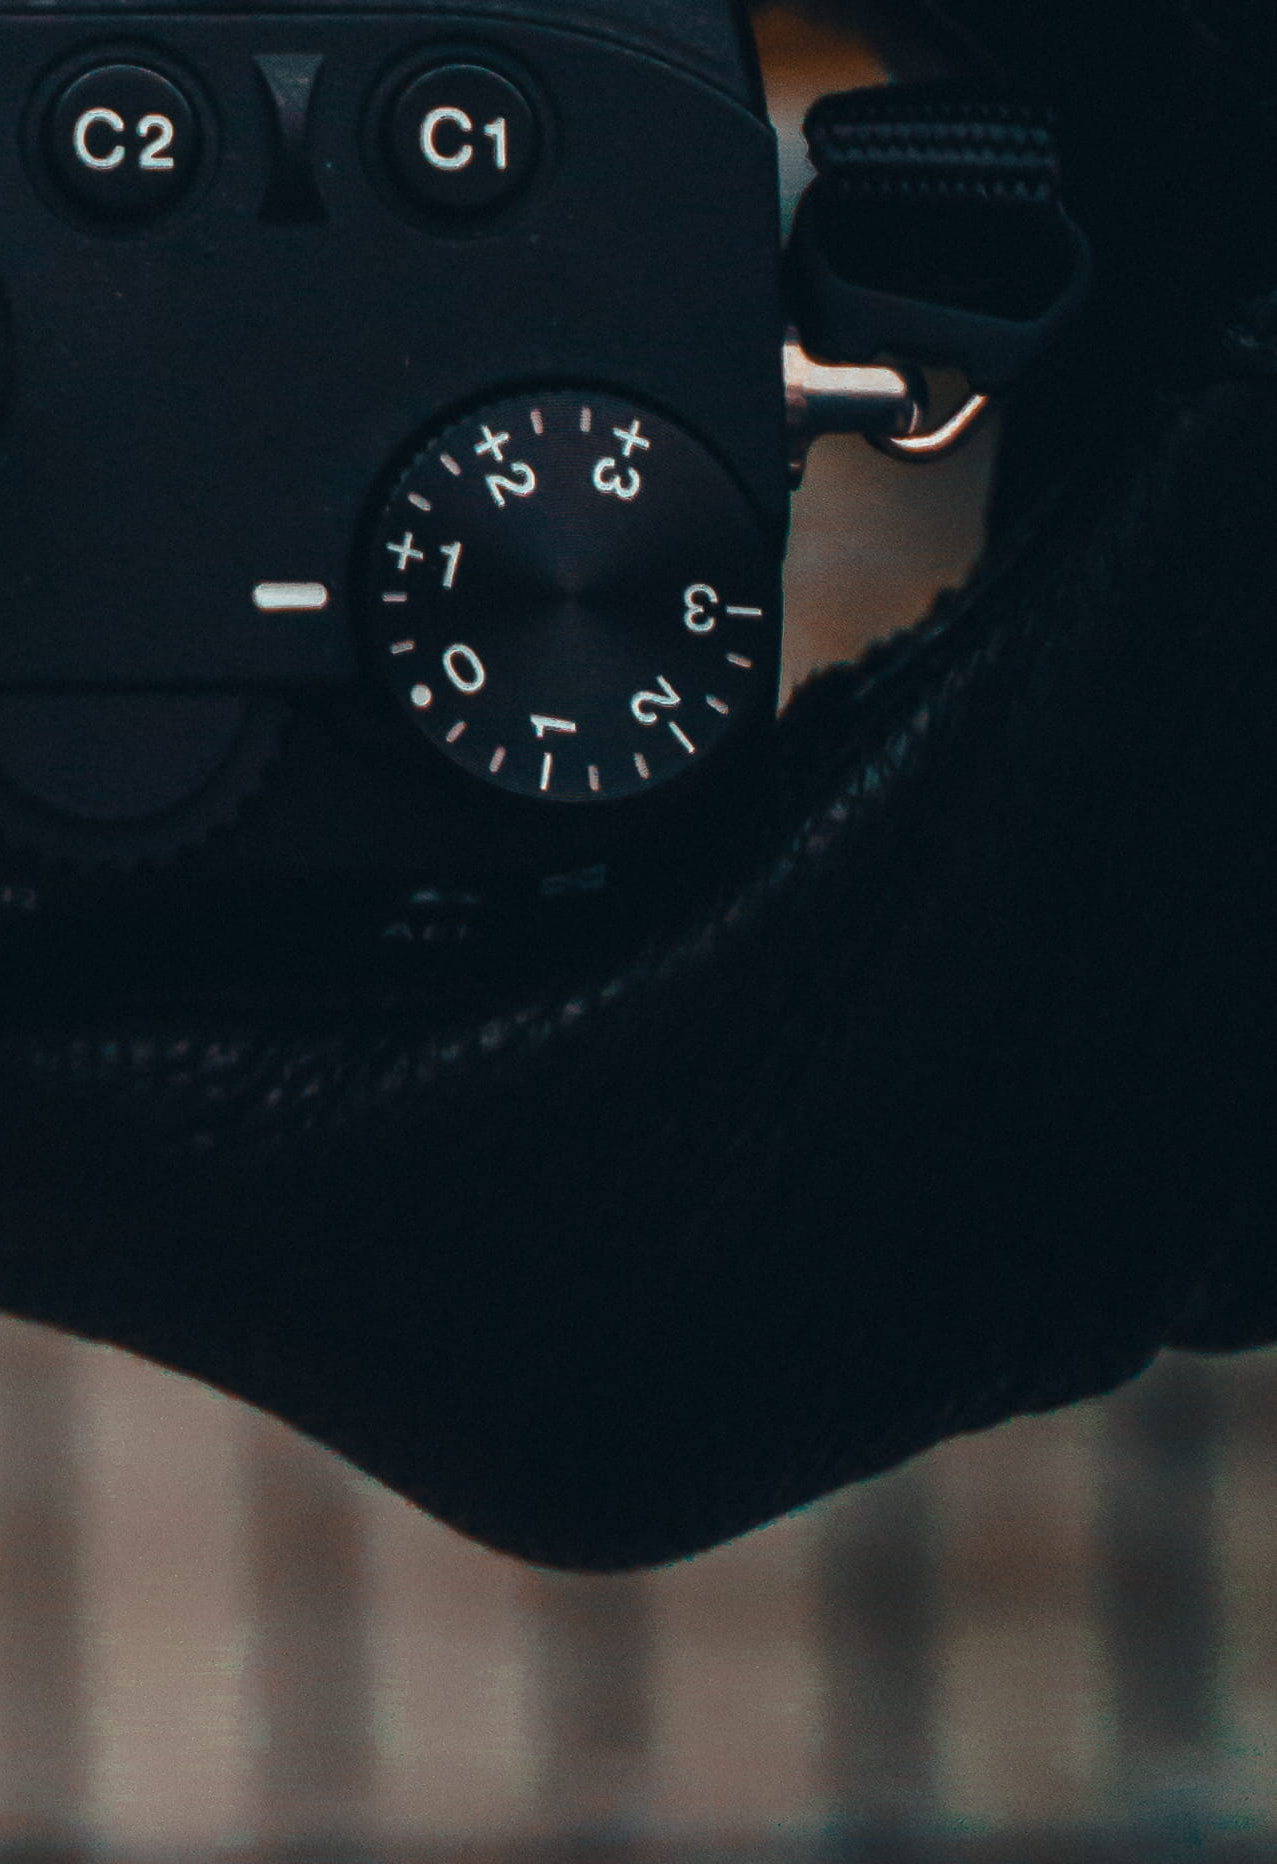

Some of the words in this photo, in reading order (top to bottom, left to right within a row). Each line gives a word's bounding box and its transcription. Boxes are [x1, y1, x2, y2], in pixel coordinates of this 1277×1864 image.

[72, 106, 176, 171] C2
[419, 105, 508, 171] C1
[441, 642, 487, 695] 0
